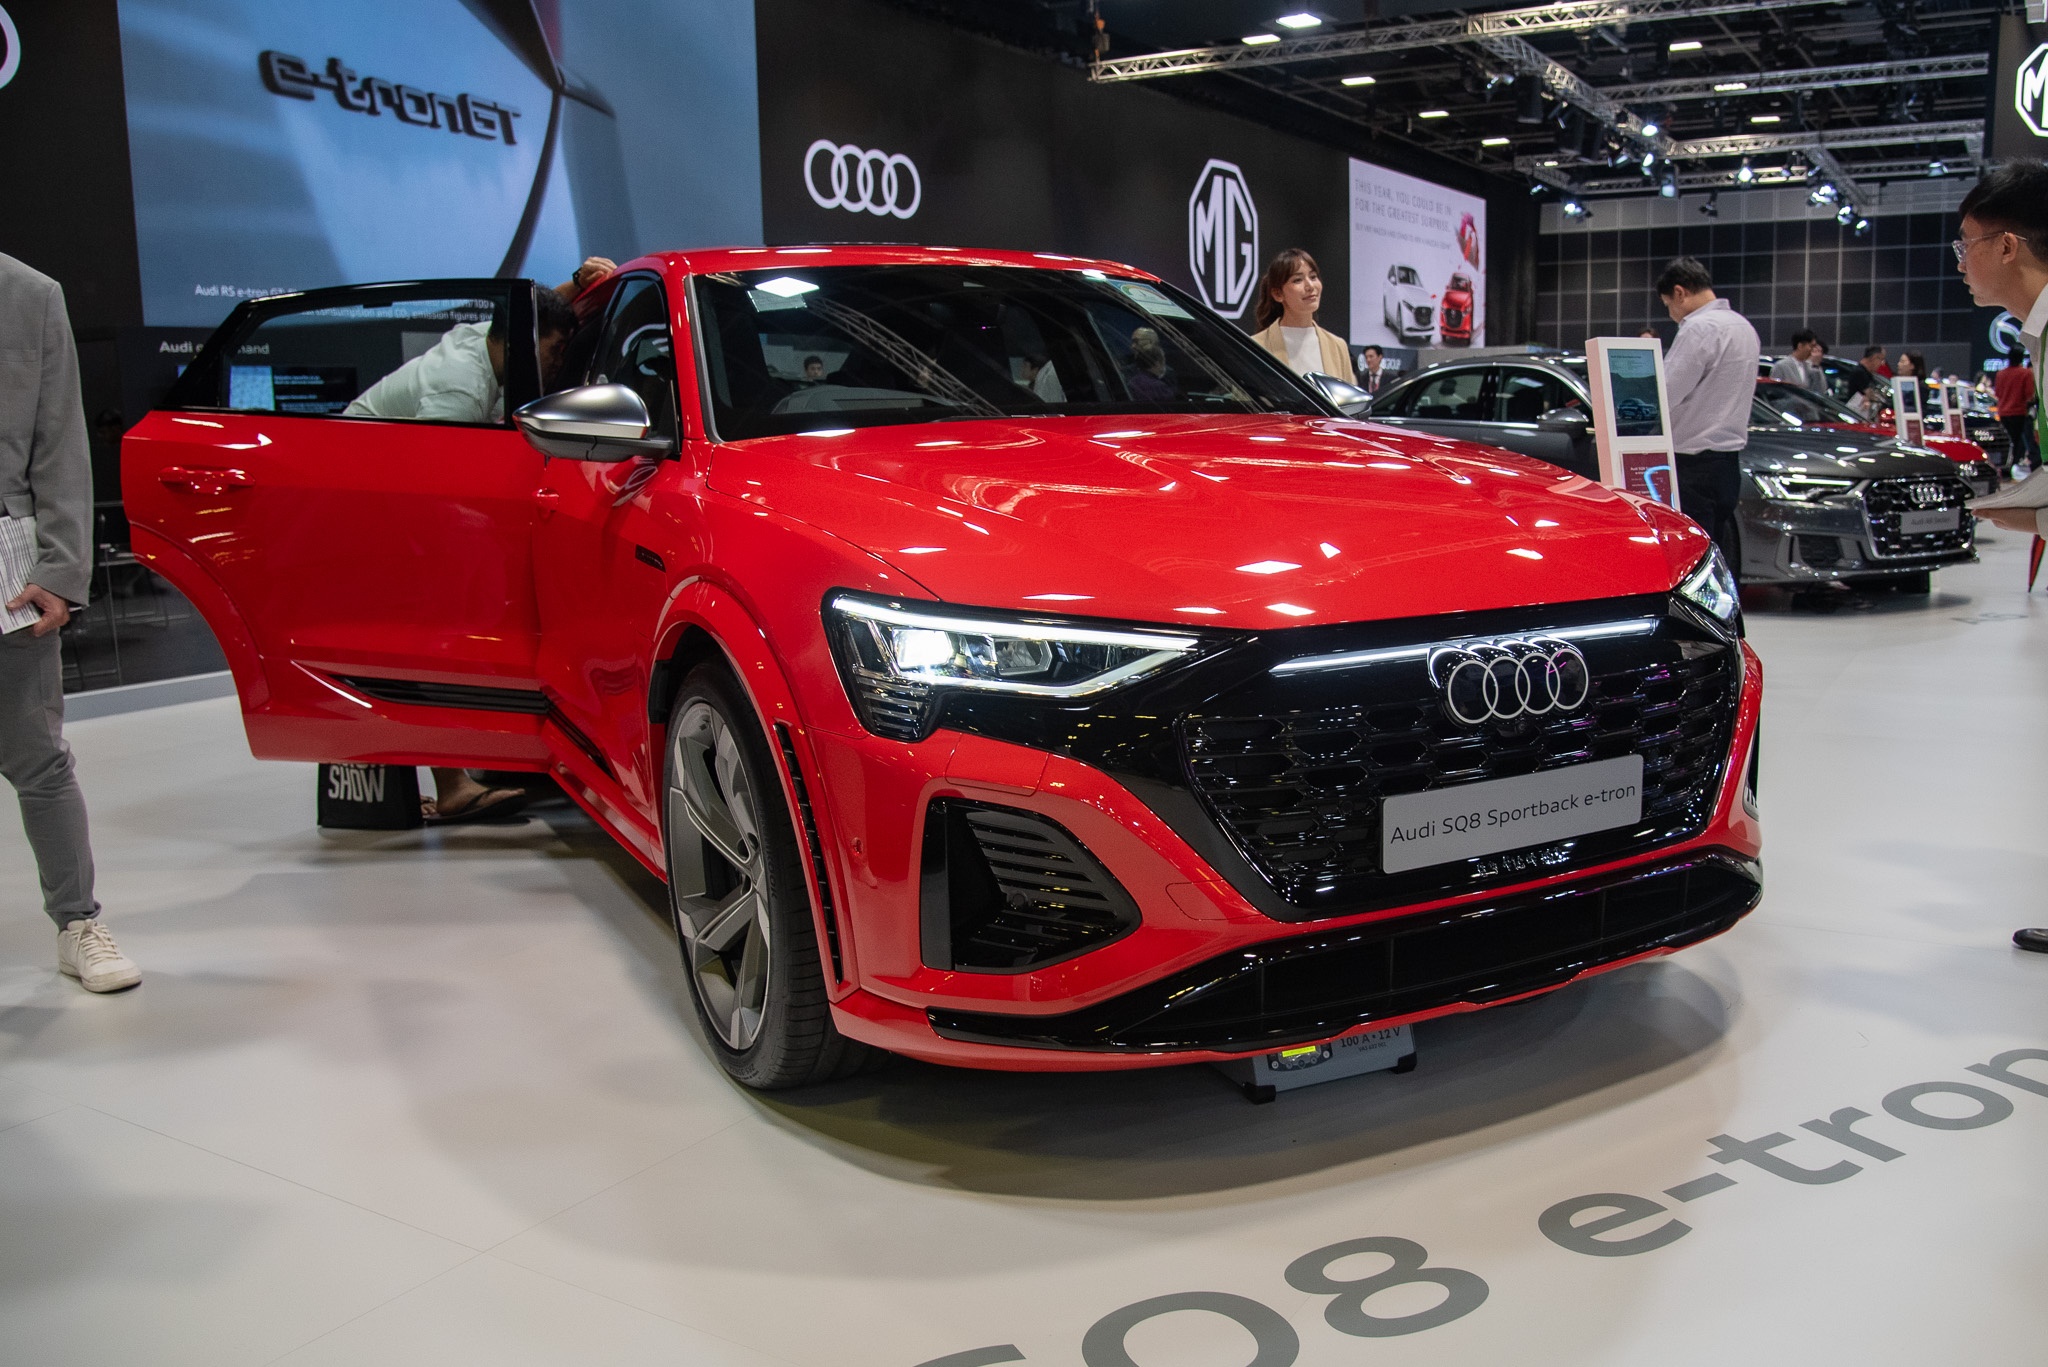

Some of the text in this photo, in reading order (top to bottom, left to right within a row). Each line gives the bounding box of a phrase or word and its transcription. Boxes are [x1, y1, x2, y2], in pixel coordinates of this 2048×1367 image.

[1354, 179, 1371, 195] THIS
[1396, 191, 1410, 206] YOU
[1412, 195, 1434, 212] COULD
[1436, 202, 1444, 215] BE
[1354, 198, 1369, 213] FOR
[1372, 201, 1385, 217] THE
[1387, 206, 1419, 224] GREATEST
[1196, 175, 1253, 305] MG
[195, 284, 219, 297] Audi
[221, 285, 236, 298] RS
[237, 287, 269, 299] e-tron
[412, 309, 449, 319] emission
[450, 310, 478, 322] figures
[160, 341, 193, 353] Audi
[328, 764, 386, 803] SHOW
[1391, 785, 1636, 844] Audi SQ8 Sportback e-tron
[1340, 1026, 1400, 1048] 100 A 12 V
